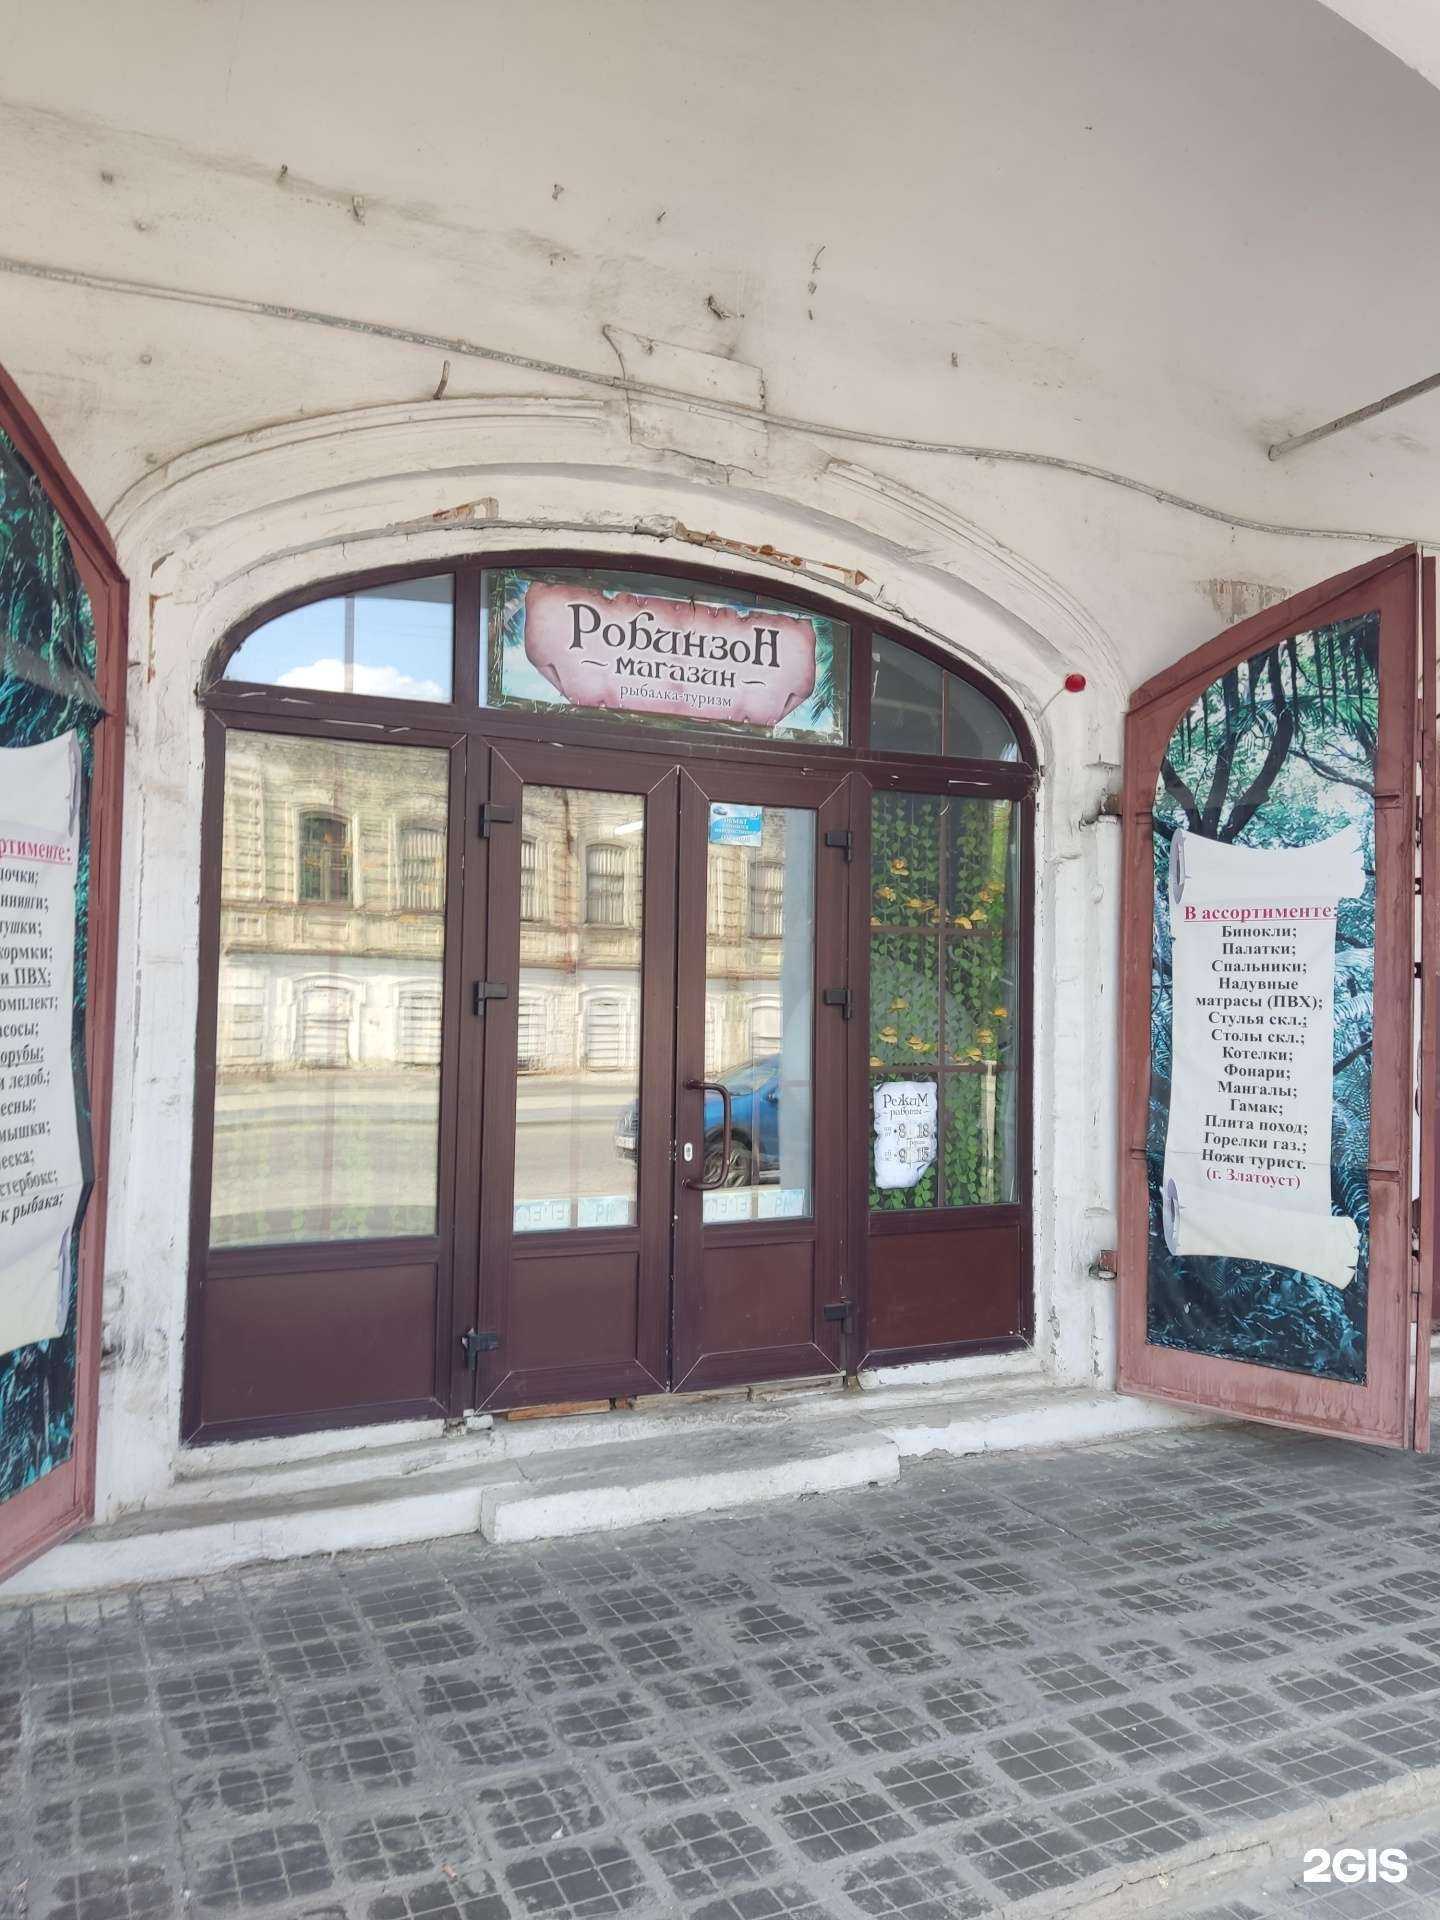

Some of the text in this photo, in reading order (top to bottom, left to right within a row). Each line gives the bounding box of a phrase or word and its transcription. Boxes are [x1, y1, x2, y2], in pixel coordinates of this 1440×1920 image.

[568, 603, 781, 668] Робинзон
[614, 655, 737, 688] магазин
[619, 682, 732, 709] рыбалка-туризм
[1184, 905, 1338, 923] В ассортименте:
[1221, 925, 1297, 939] Бинокли;
[1222, 942, 1296, 956] Палатки;
[1211, 959, 1307, 974] Спальники;
[1218, 977, 1299, 992] Надувные
[1195, 995, 1324, 1011] матрасы (ПВХ);
[1208, 1011, 1308, 1028] Стулья скл.;
[1211, 1028, 1305, 1046] Столы скл.;
[1221, 1046, 1294, 1061] Котелки;
[1224, 1063, 1291, 1080] Фонари;
[1217, 1081, 1298, 1098] Мангалы;
[882, 1092, 929, 1108] Режим
[1230, 1099, 1284, 1116] Гамак;
[1204, 1114, 1309, 1135] Плита поход;
[1204, 1132, 1307, 1153] Горелки газ.;
[0, 1149, 35, 1170] еска;
[1202, 1149, 1307, 1170] Ножи турист.
[1206, 1167, 1301, 1189] (г. Златоуст)
